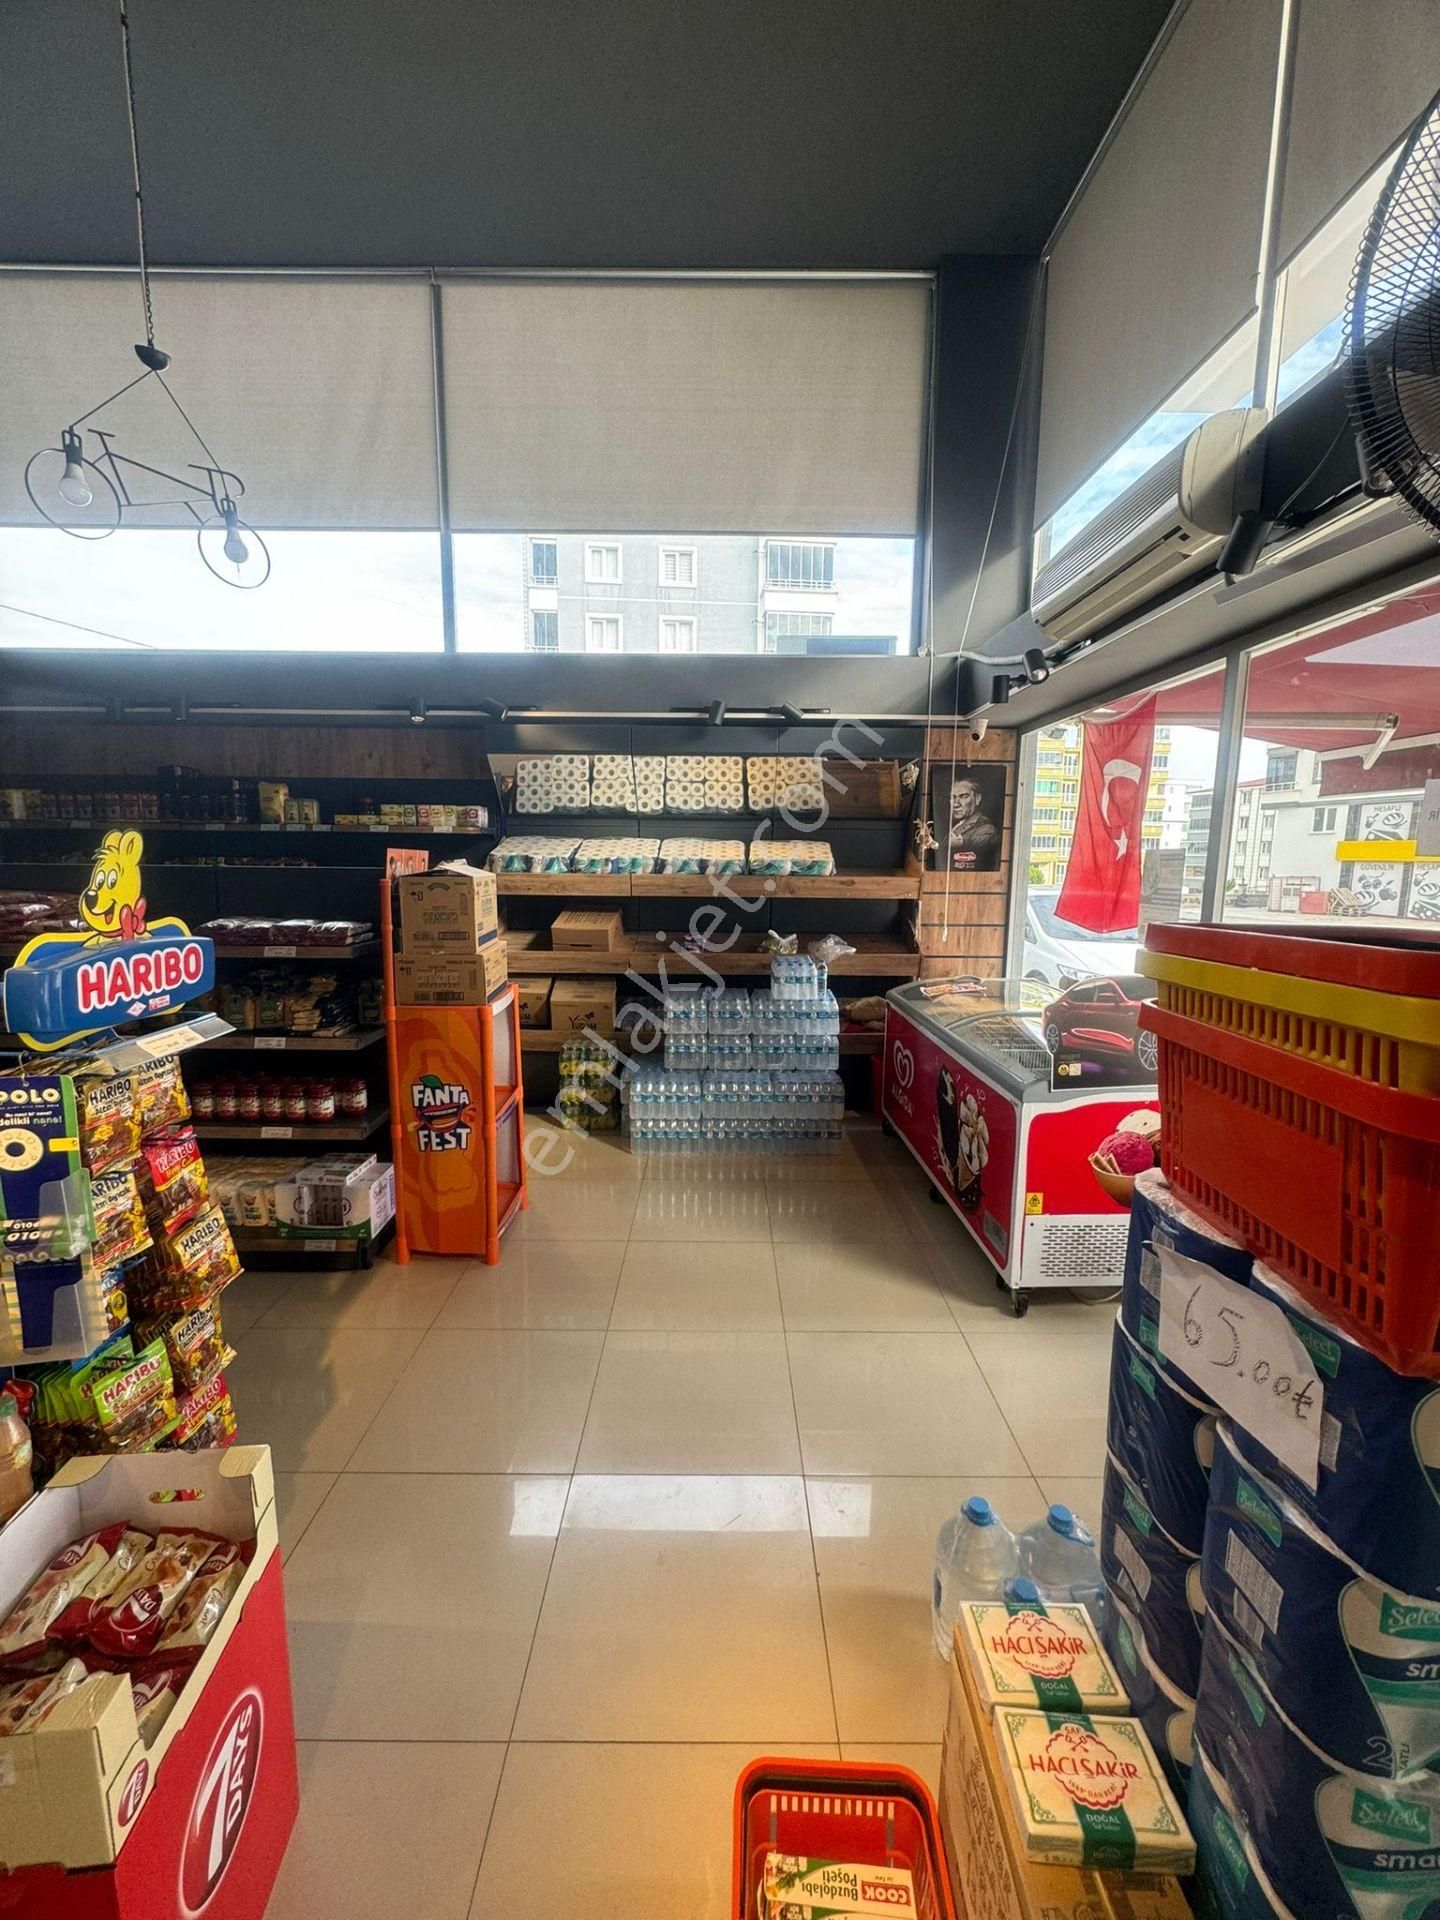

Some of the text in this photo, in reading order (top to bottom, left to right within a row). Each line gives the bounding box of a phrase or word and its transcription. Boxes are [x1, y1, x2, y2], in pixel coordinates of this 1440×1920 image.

[78, 943, 203, 1013] HARIBO
[139, 1055, 174, 1075] ARIBO
[90, 1078, 132, 1106] HARIBO
[411, 1085, 470, 1108] FANTA
[418, 1127, 471, 1151] FEST
[156, 1140, 196, 1174] HARIBO
[92, 1175, 128, 1198] ARIBO
[181, 1216, 221, 1251] HARIBO
[101, 1354, 162, 1406] HARIBO
[991, 1635, 1034, 1655] HACI
[1028, 1753, 1079, 1776] HACI
[822, 1867, 858, 1888] Poşeti
[801, 1881, 859, 1902] Buzdolabı
[864, 1885, 908, 1904] COOK
